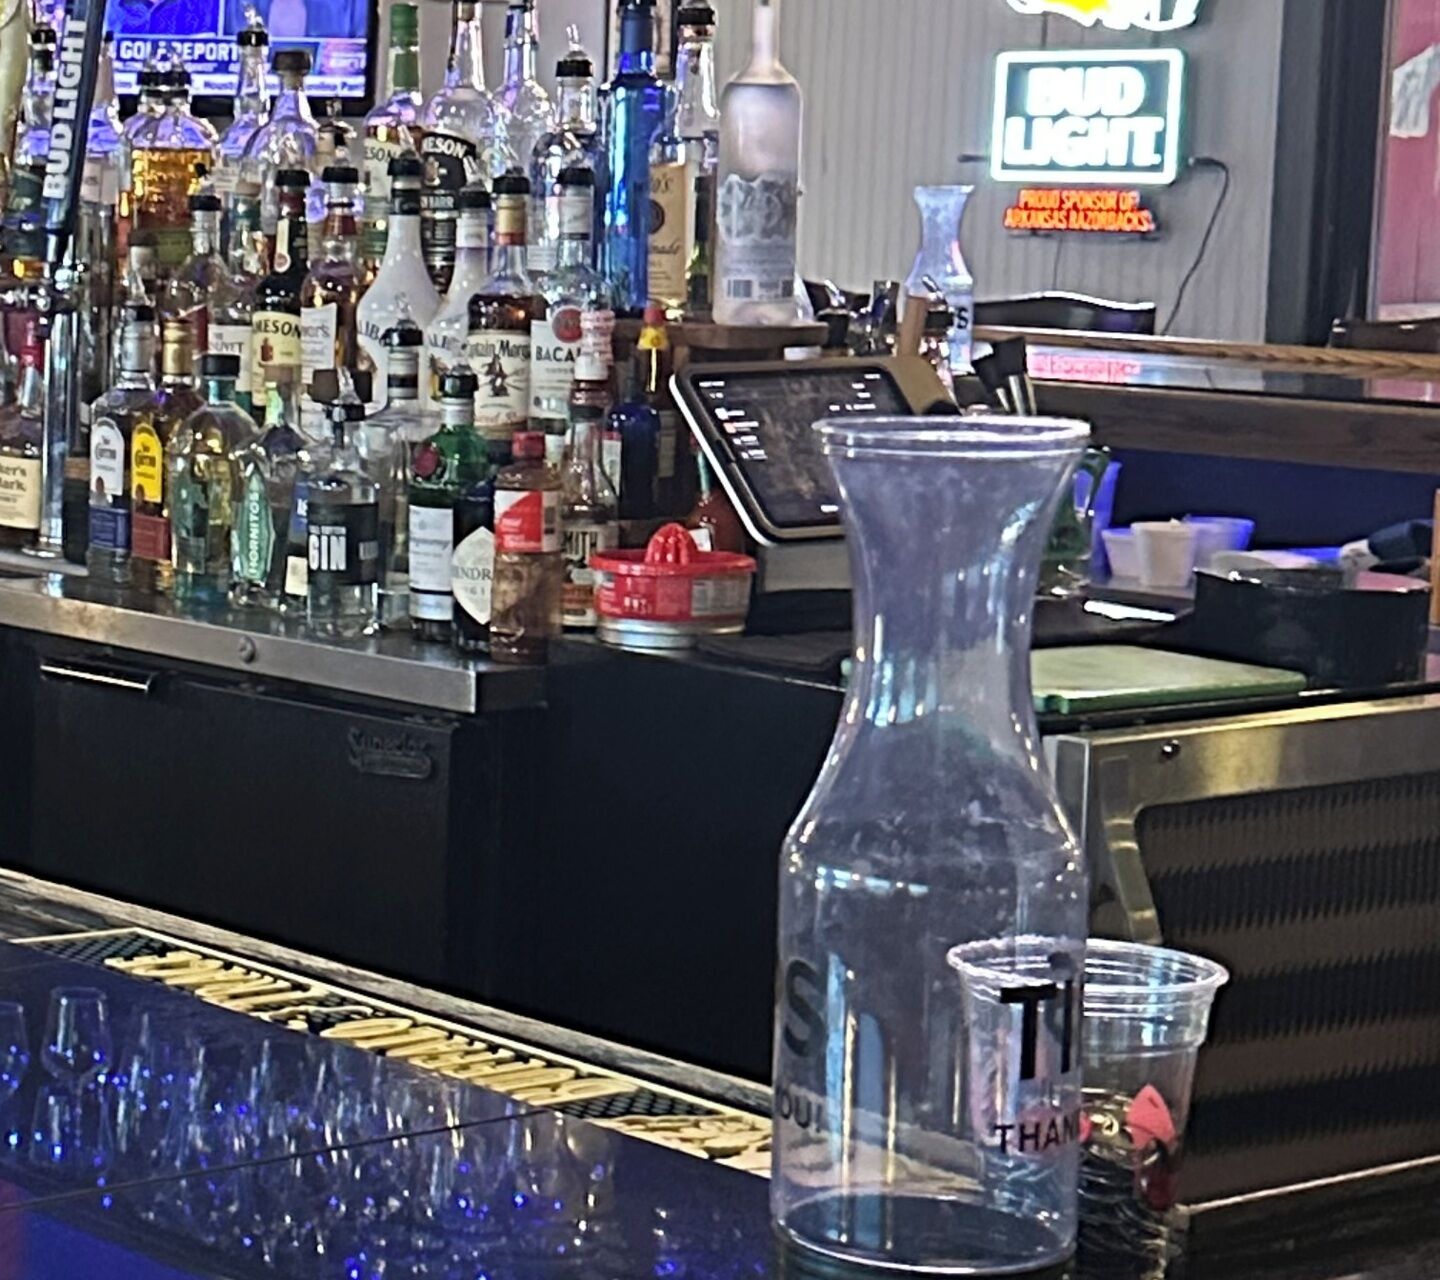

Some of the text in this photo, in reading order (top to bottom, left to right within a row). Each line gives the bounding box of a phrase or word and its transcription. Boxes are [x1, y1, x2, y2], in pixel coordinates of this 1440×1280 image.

[42, 15, 88, 200] BUD LIGHT
[1025, 66, 1146, 117] BUD
[1061, 189, 1117, 210] SPONSOR
[248, 491, 260, 574] HORNITOS
[309, 534, 347, 571] GIN
